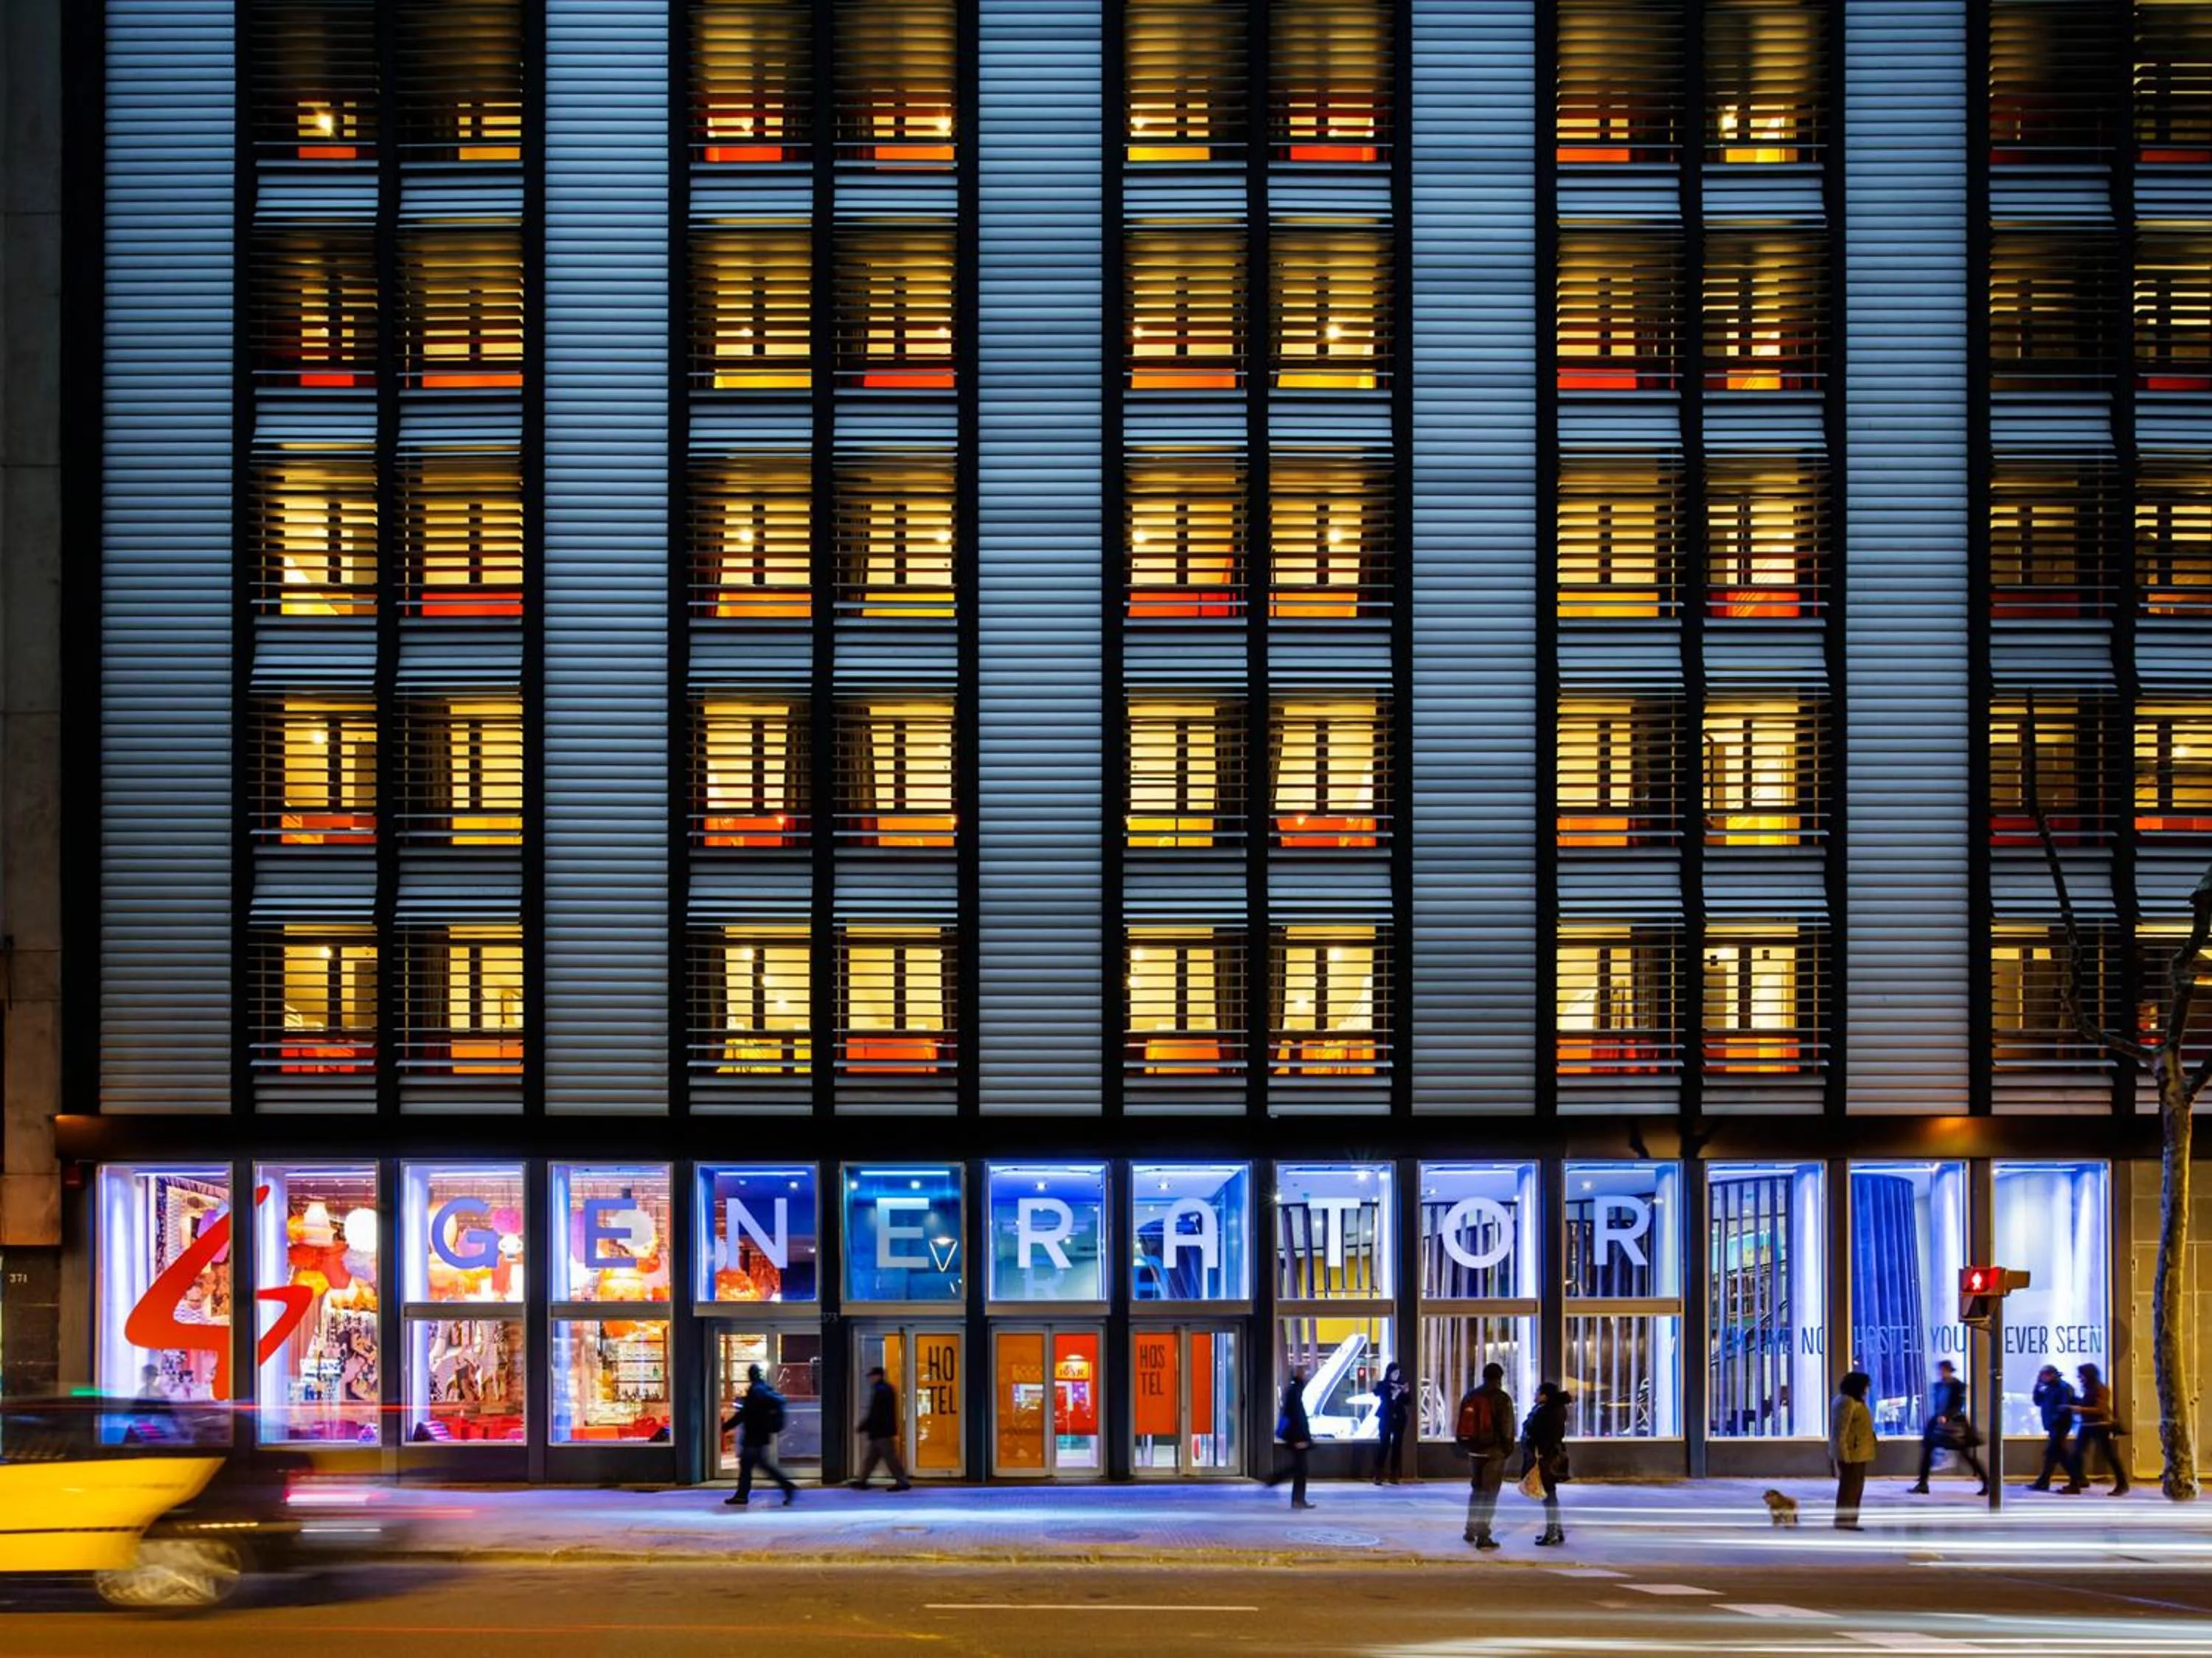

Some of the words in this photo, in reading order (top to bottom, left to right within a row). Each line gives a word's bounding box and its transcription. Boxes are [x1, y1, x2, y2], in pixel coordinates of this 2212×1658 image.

[431, 1195, 1651, 1272] GENERATOR
[10, 1274, 27, 1283] 371
[1854, 1325, 1922, 1354] HOSTEL
[2005, 1325, 2048, 1353] EVER
[2056, 1325, 2102, 1353] SEEN
[928, 1345, 955, 1381] HO
[1139, 1345, 1165, 1369] HOS
[1140, 1371, 1164, 1395] TEL
[928, 1385, 957, 1415] TEL
